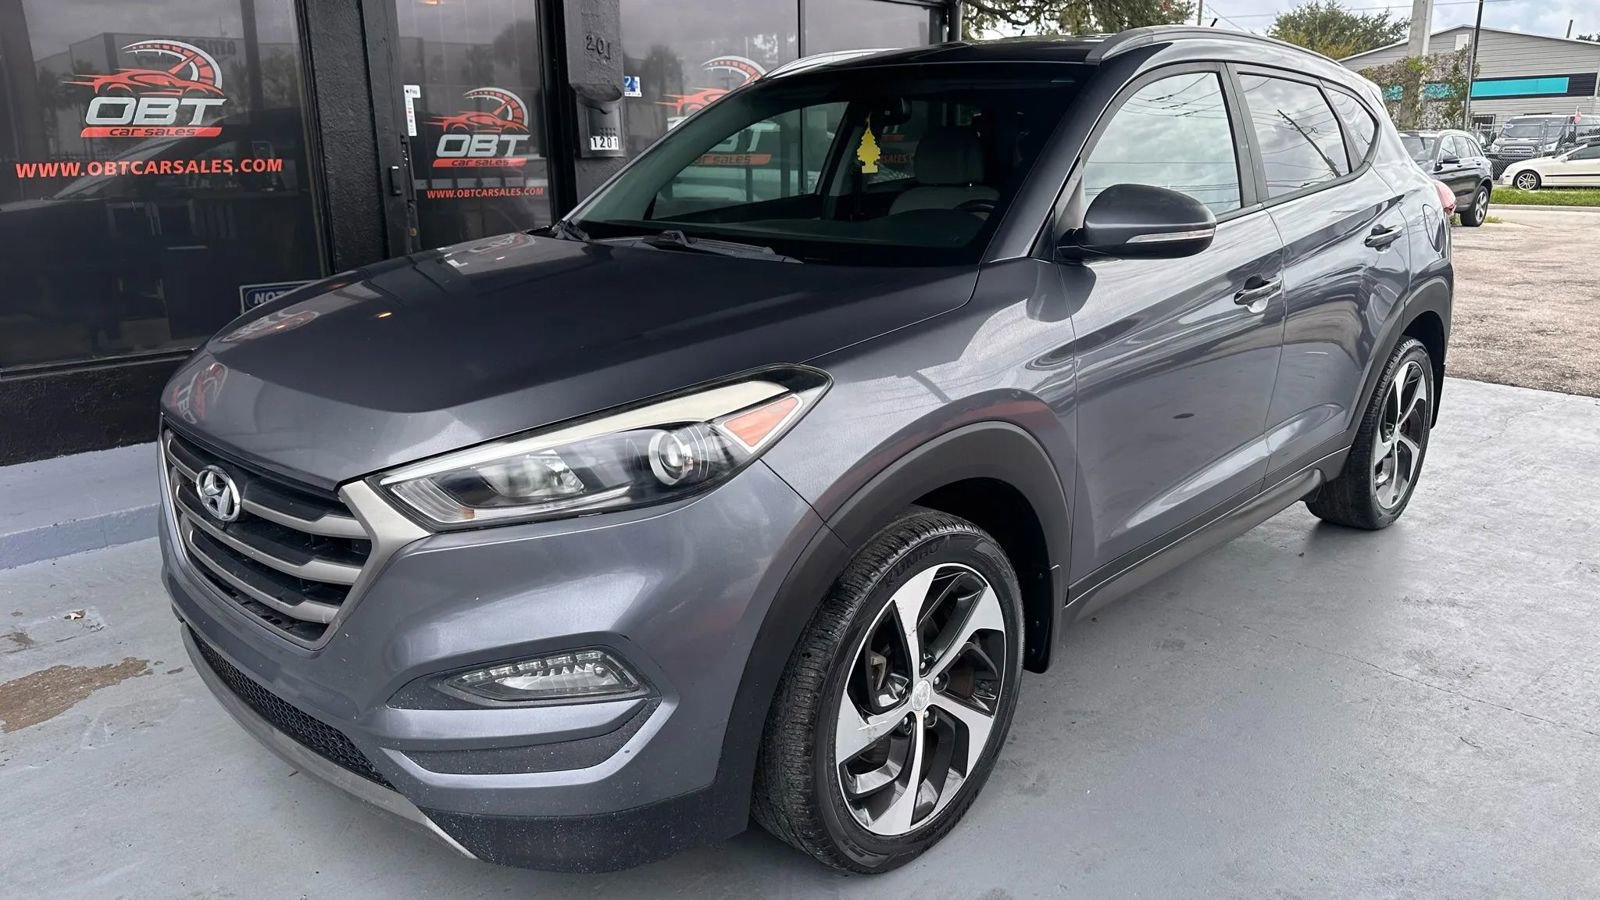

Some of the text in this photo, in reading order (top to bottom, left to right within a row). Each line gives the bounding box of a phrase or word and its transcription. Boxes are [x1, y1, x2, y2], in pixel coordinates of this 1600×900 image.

[85, 96, 227, 126] OBT
[109, 128, 196, 137] car sales
[436, 134, 531, 157] OBT
[592, 137, 618, 149] 1201
[15, 158, 283, 178] WWW.OBTCARSALES.COM
[451, 159, 509, 167] car sales
[426, 187, 544, 199] WWW.OBTCARSALES.COM
